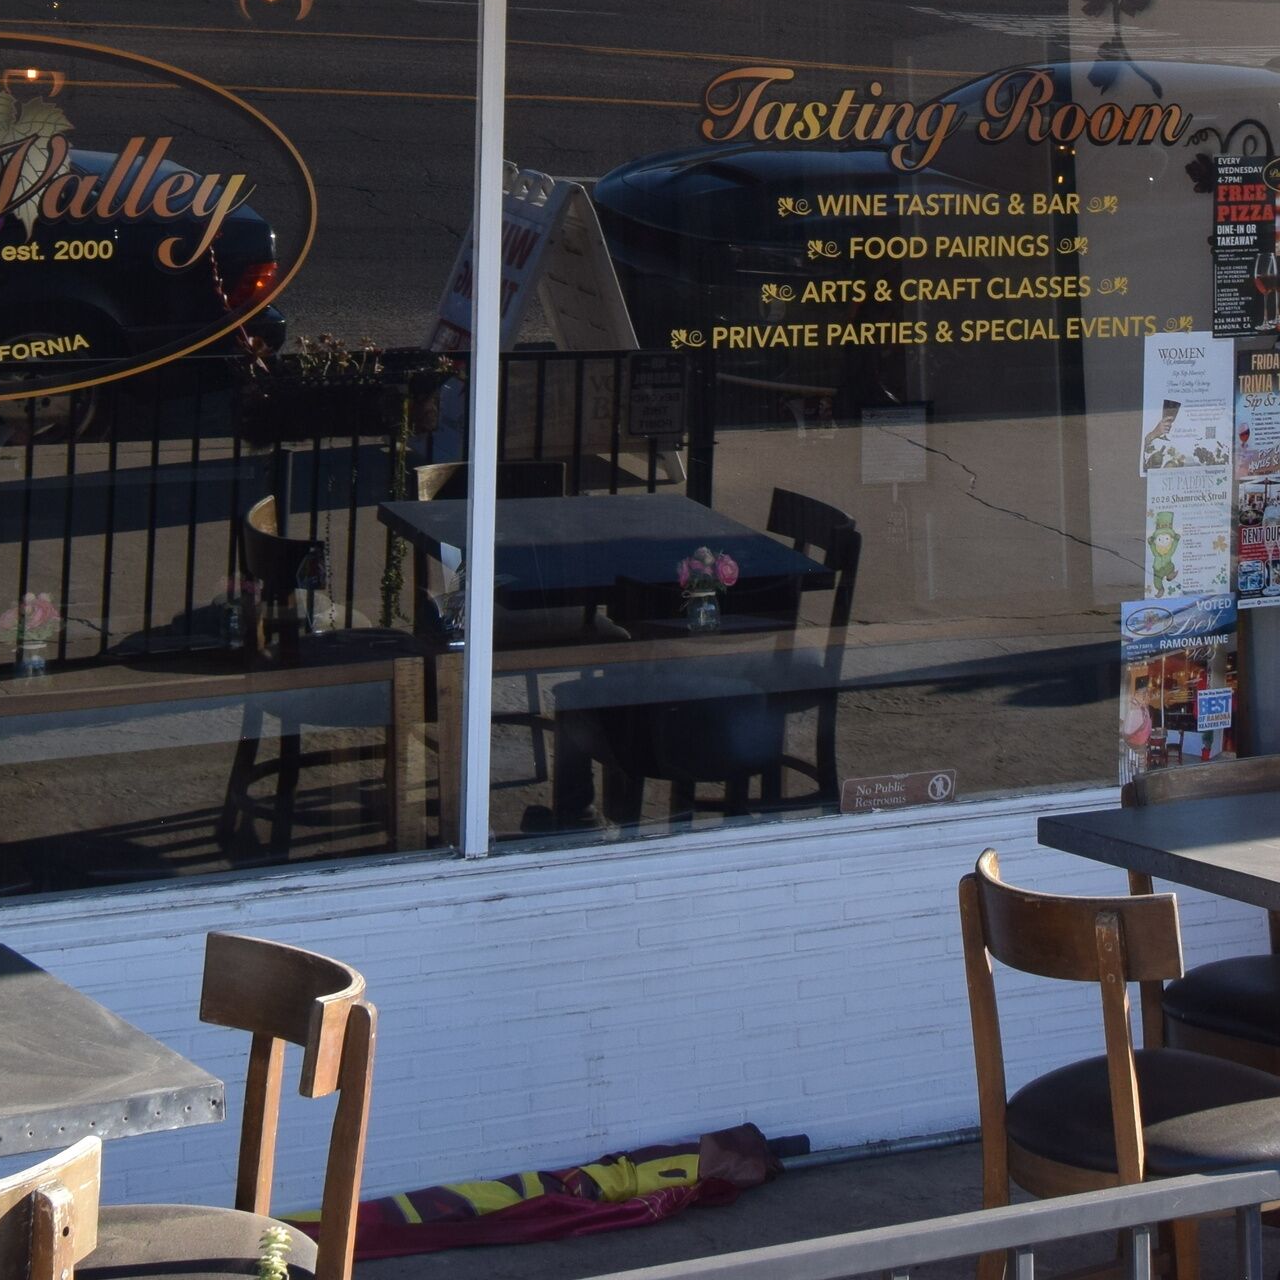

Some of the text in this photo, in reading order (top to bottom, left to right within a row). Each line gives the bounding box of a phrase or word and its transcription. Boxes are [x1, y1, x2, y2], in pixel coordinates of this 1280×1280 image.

[699, 66, 1193, 172] Tasting Room
[1218, 157, 1240, 165] EVERY
[1218, 166, 1263, 174] WEDNESDAY
[1217, 184, 1266, 202] FREE
[817, 192, 1081, 217] WINE TASTING & BAR
[1217, 204, 1274, 222] PIZZA
[1217, 224, 1257, 235] DINE-IN OR
[0, 242, 45, 262] est.
[53, 239, 114, 261] 2000
[848, 234, 1050, 260] FOOD PAIRINGS
[800, 276, 1091, 304] ARTS & CRAFT CLASSES
[711, 316, 1157, 350] PRIVATE PARTIES & SPECIAL EVENTS
[1158, 347, 1205, 359] WOMEN
[1238, 374, 1273, 393] TRIVIA
[1244, 394, 1262, 411] Sip
[1264, 393, 1275, 406] &
[1171, 493, 1206, 504] Shamrock
[1207, 491, 1227, 502] Stroll
[1242, 528, 1263, 545] RENT
[1196, 598, 1231, 611] VOTED
[1159, 634, 1229, 649] RAMONA WINE
[1199, 696, 1231, 715] BEST
[1207, 713, 1231, 721] RAMONA
[855, 781, 905, 796] No Public
[854, 796, 906, 808] Restrooms
